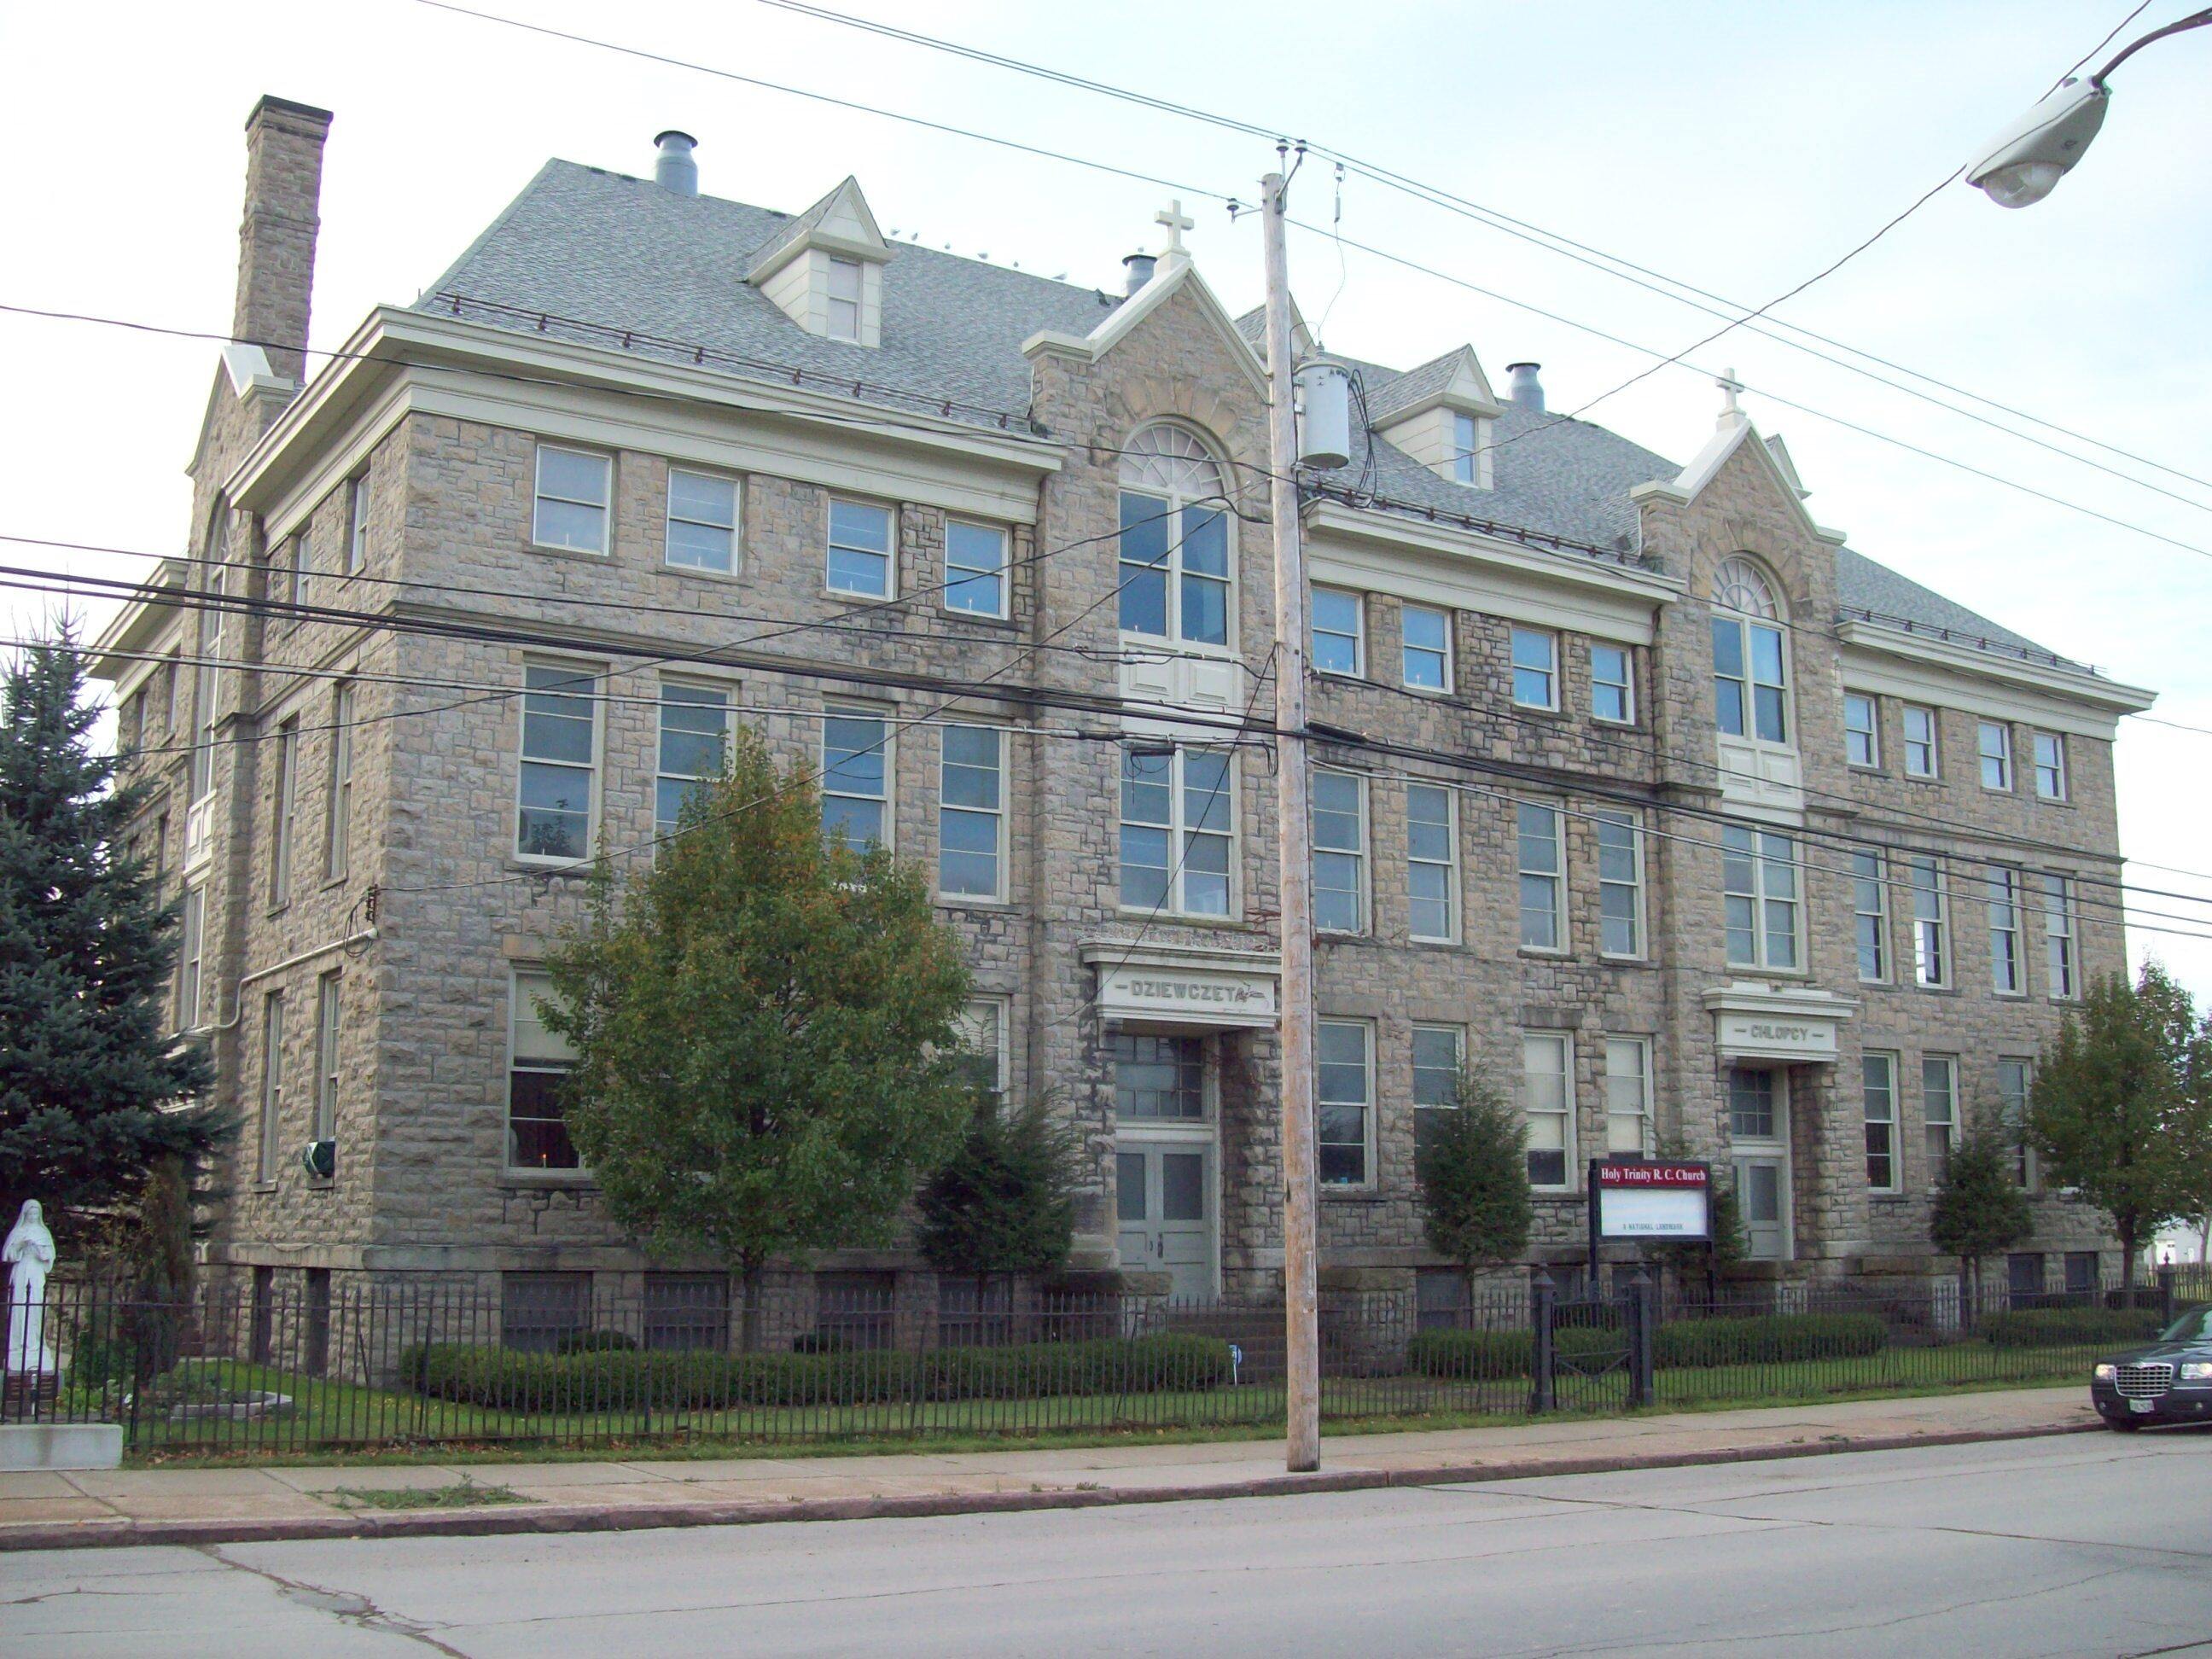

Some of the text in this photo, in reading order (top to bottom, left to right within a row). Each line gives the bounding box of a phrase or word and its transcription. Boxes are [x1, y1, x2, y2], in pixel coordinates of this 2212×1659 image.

[1131, 980, 1248, 1004] DZIEWCZETA
[1601, 1167, 1621, 1182] Holy
[1623, 1168, 1651, 1183] Trinity
[1664, 1168, 1674, 1181] C.
[1675, 1169, 1706, 1181] Church
